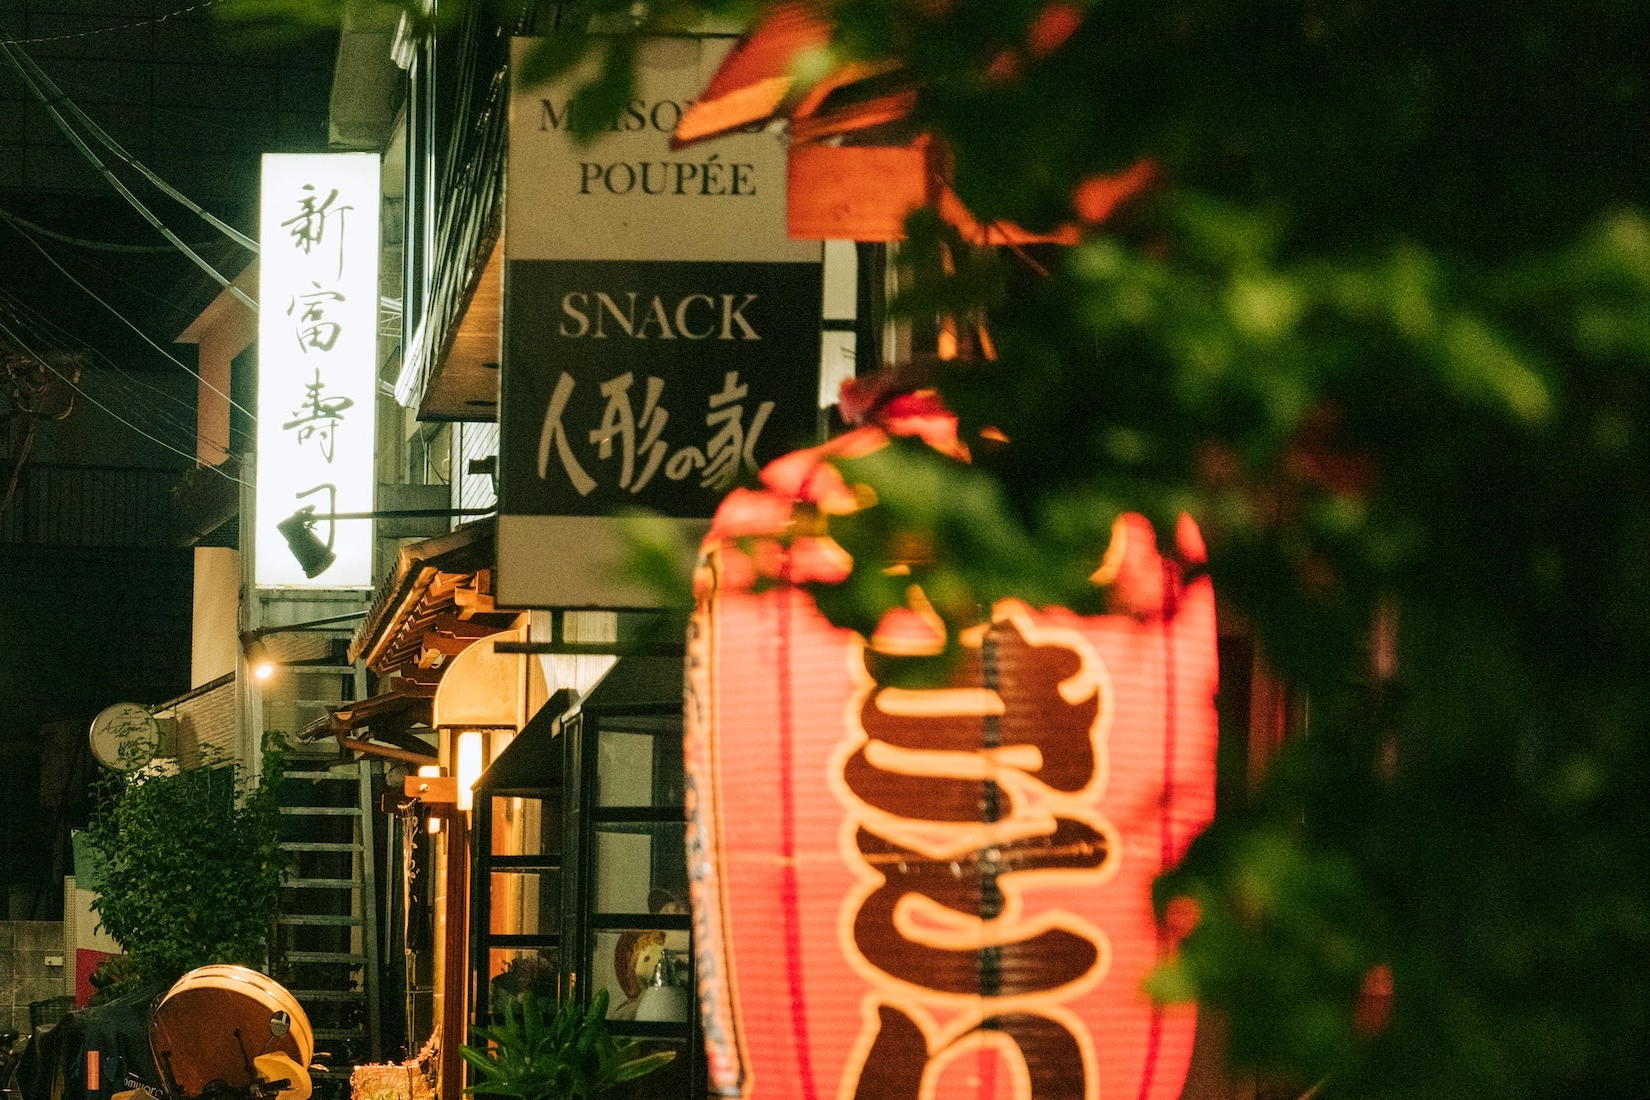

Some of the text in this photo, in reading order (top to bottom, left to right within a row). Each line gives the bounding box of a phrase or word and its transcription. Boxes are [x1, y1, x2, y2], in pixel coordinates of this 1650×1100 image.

[538, 98, 698, 134] MSO
[578, 153, 758, 196] POUPÉE
[558, 291, 763, 341] SNACK
[537, 370, 776, 497] 人形の家
